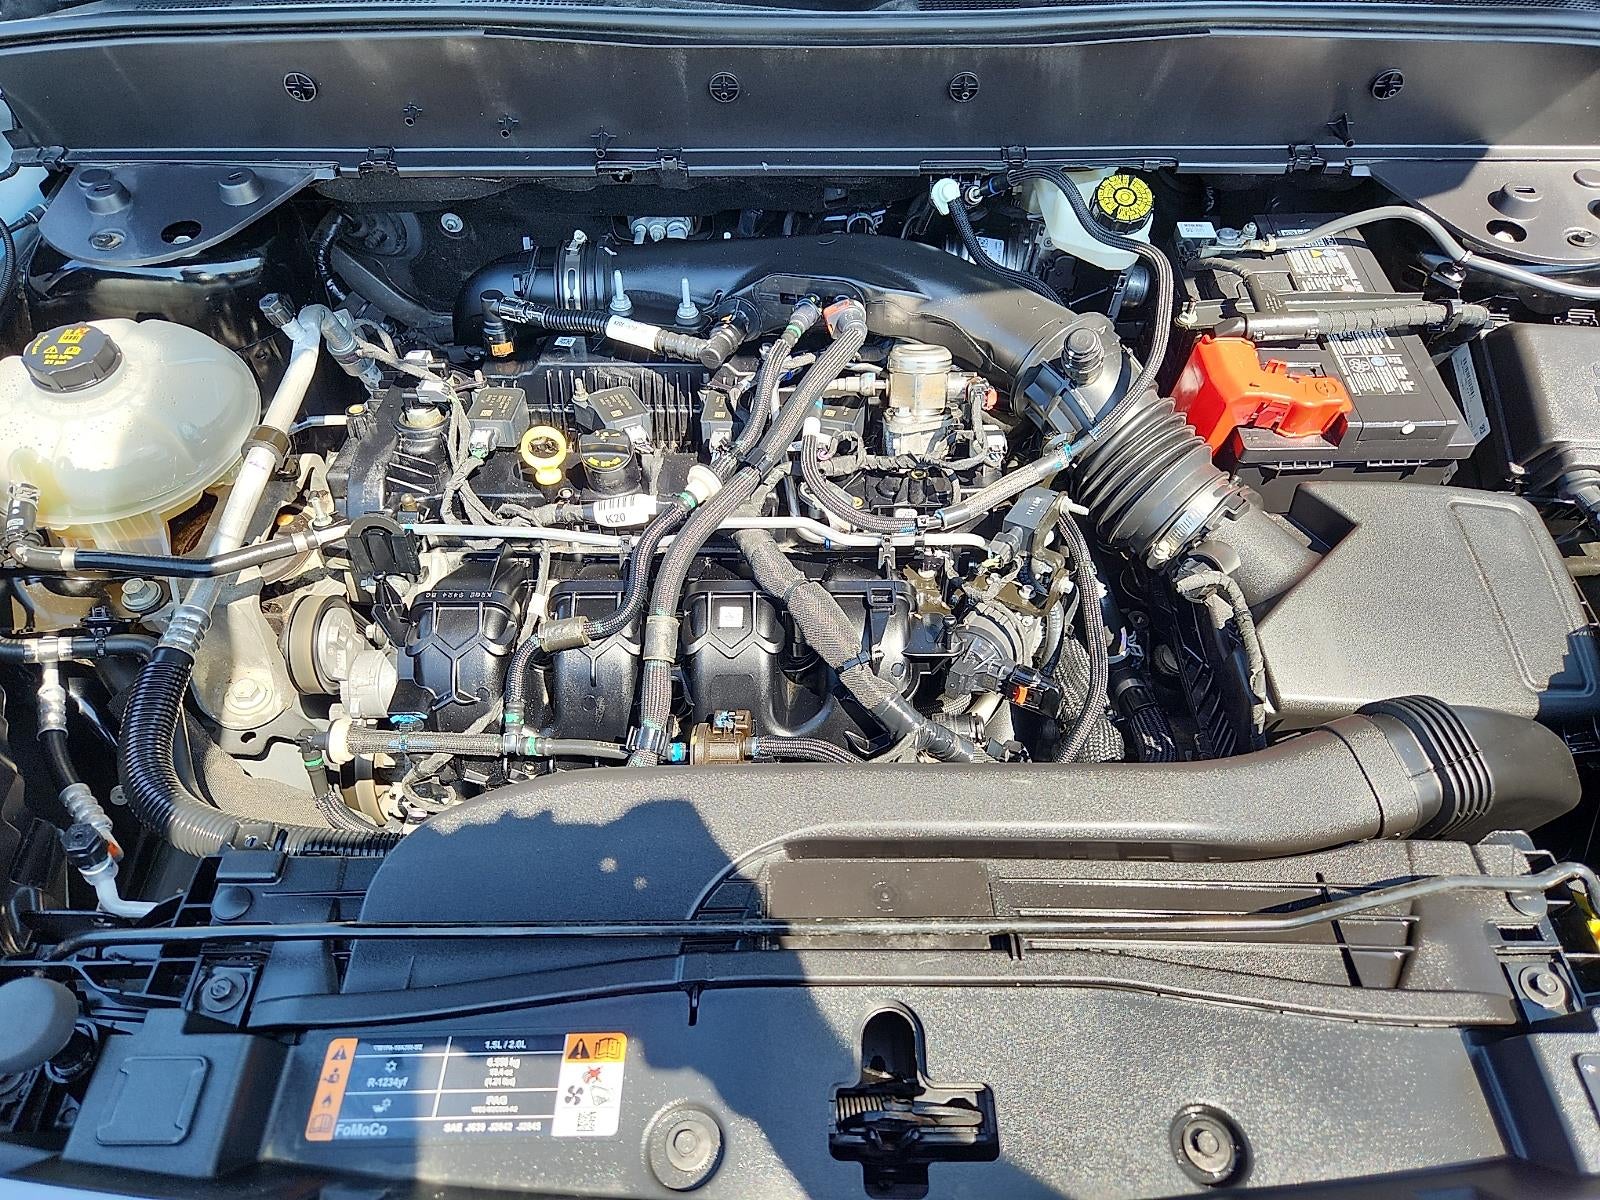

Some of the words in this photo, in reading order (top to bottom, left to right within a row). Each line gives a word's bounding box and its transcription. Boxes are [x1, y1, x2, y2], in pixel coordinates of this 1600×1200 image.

[605, 512, 626, 524] K20
[366, 1076, 409, 1089] R-1234yf
[334, 1122, 388, 1137] FoMoCo
